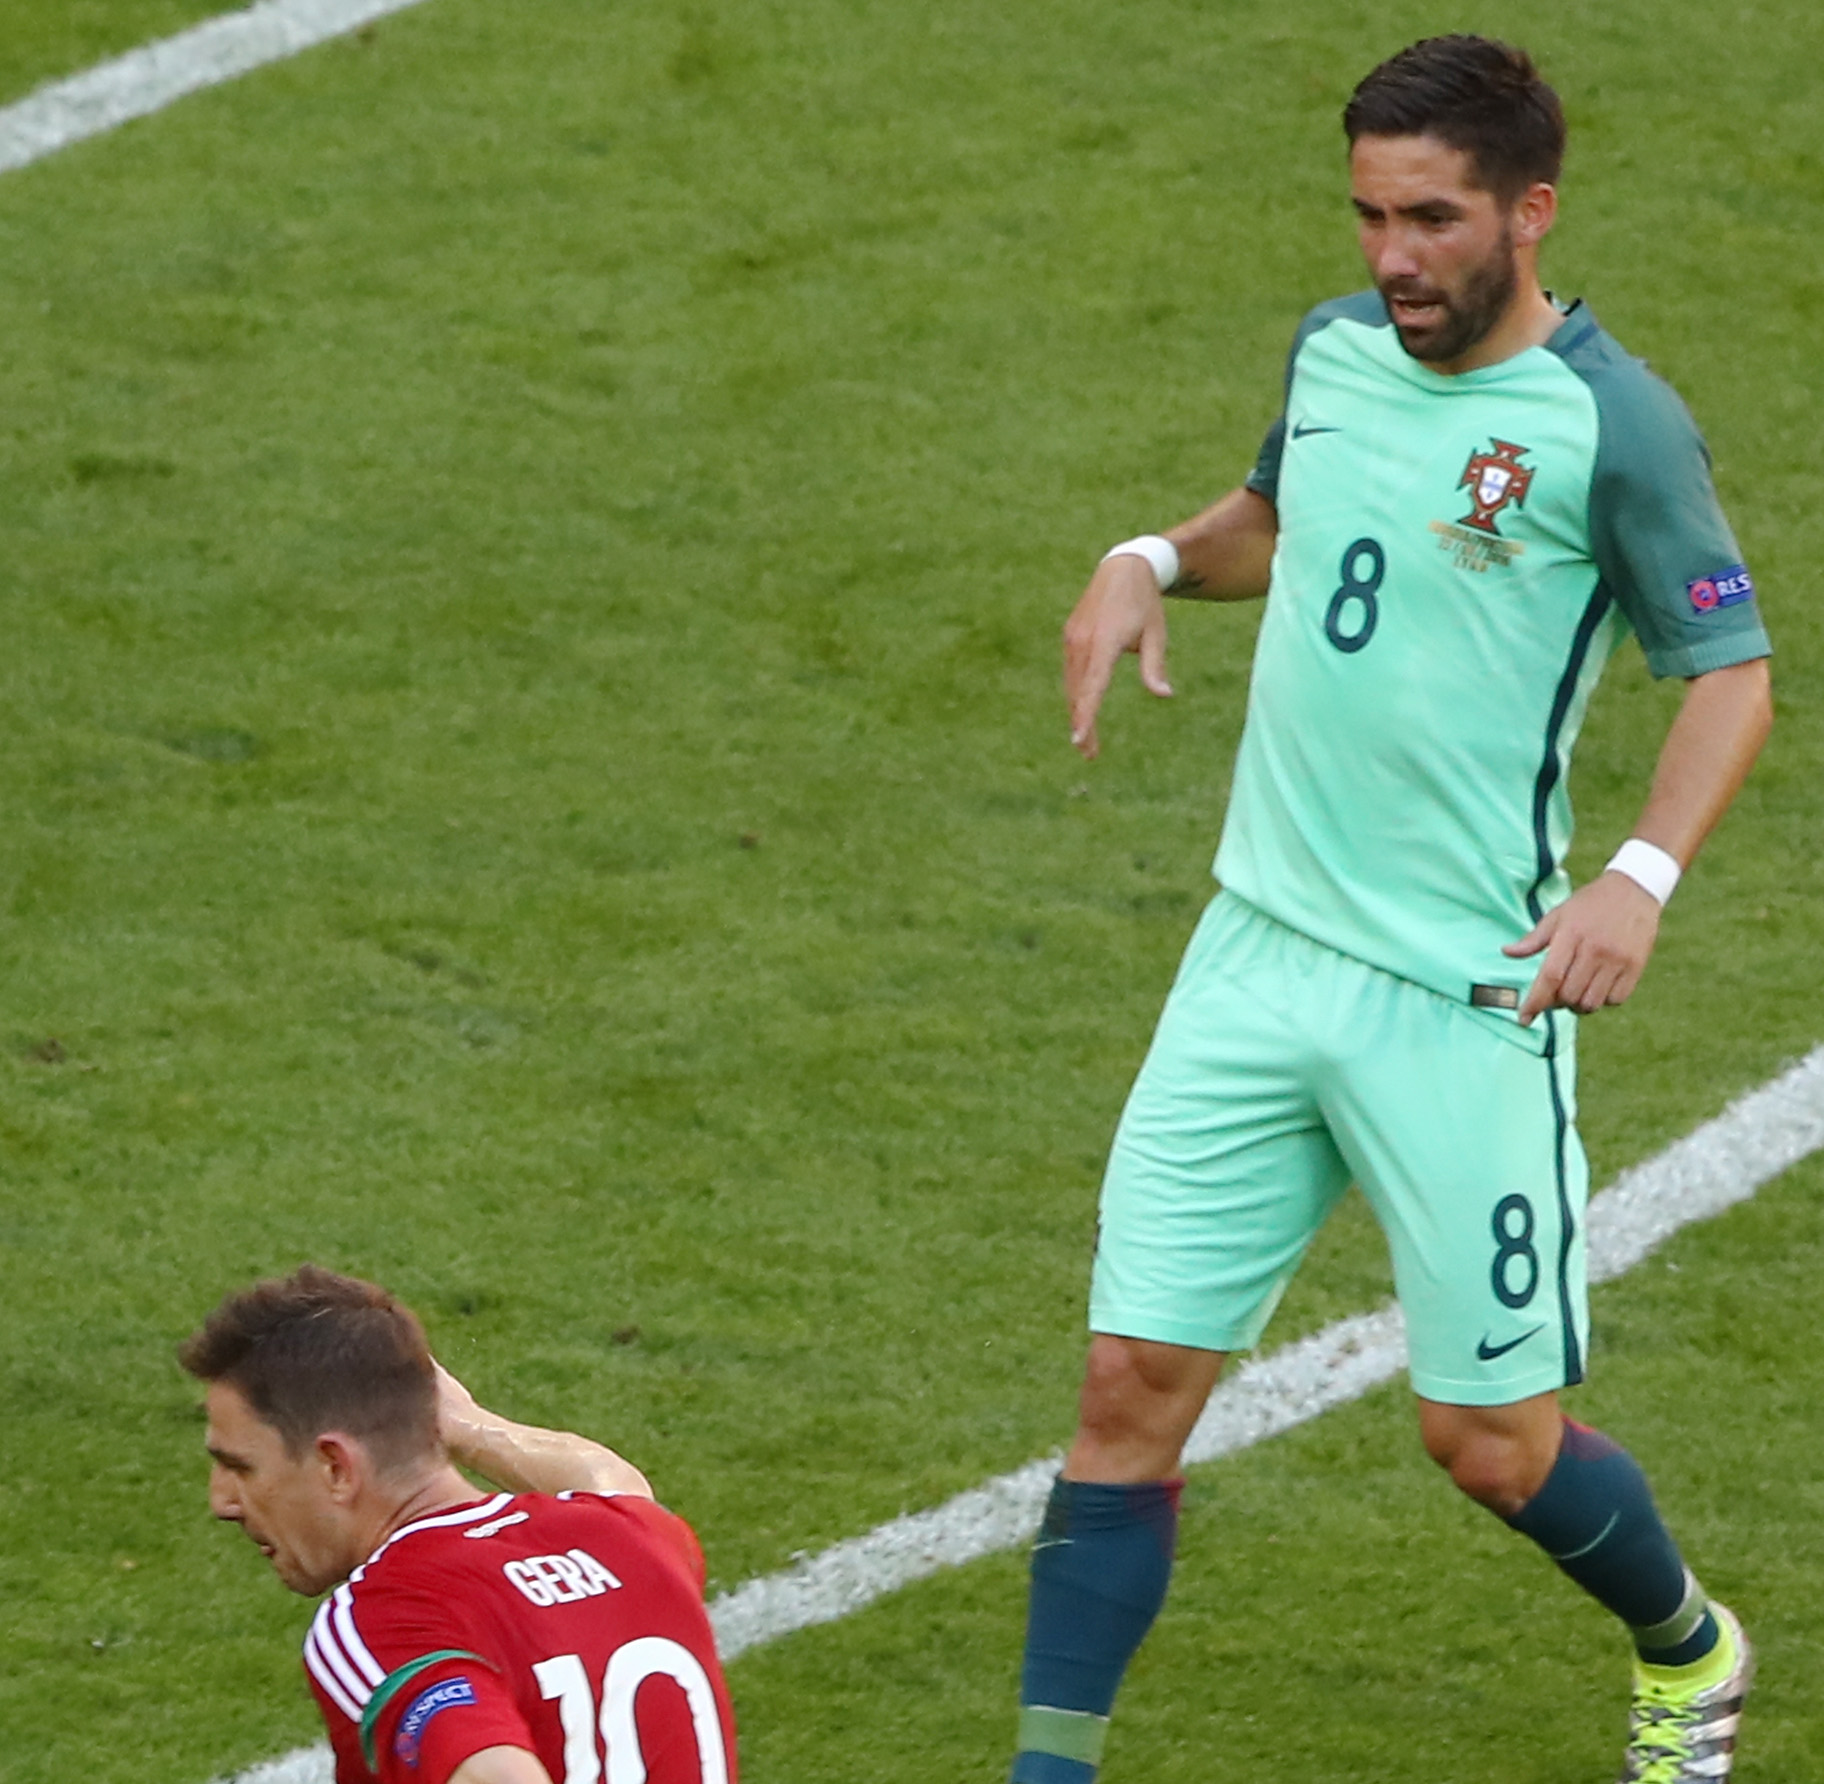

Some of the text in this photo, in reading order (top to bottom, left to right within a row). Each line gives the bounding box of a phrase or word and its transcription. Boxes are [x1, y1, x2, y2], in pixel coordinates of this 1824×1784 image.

[1325, 537, 1385, 654] 8
[1492, 1192, 1539, 1310] 8
[502, 1548, 624, 1607] GERA
